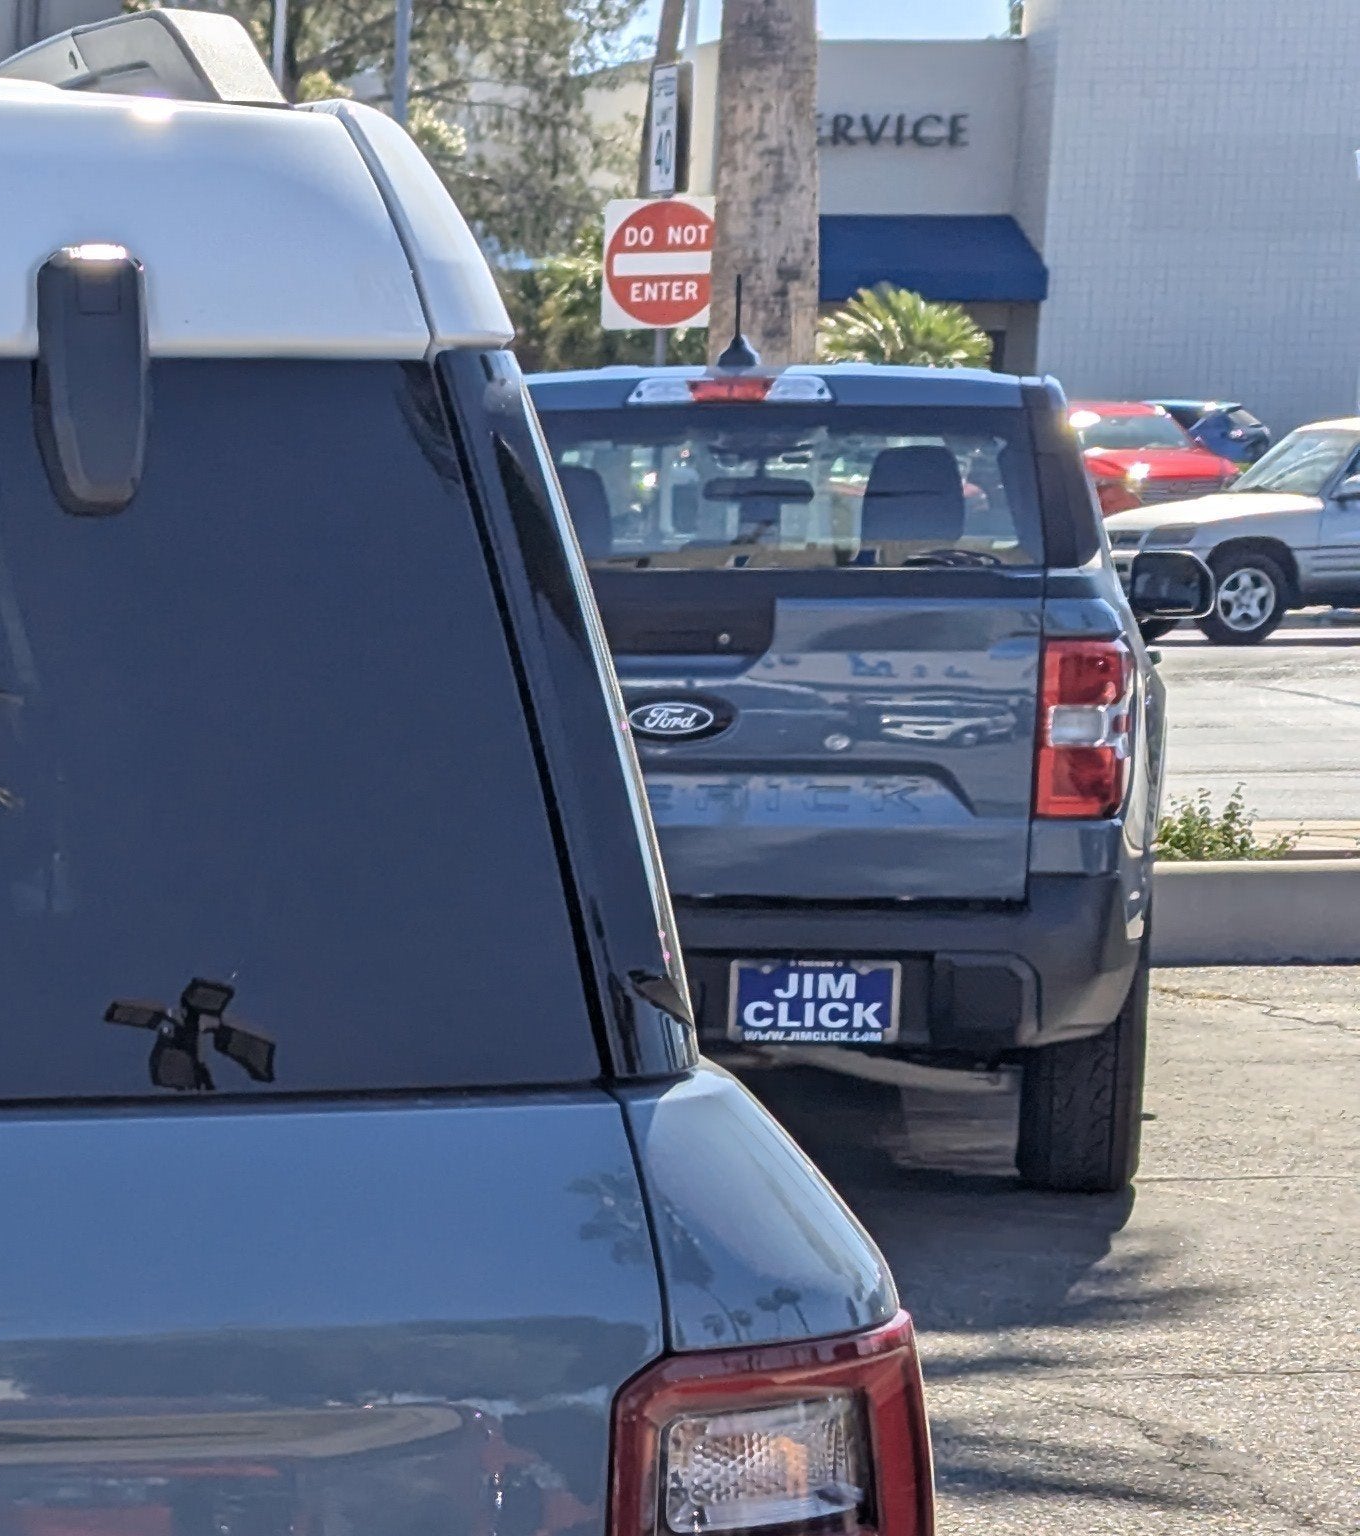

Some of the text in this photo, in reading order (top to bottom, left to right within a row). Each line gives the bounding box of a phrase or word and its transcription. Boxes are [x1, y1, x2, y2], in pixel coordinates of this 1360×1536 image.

[624, 224, 710, 247] DO NOT
[630, 281, 699, 302] ENTER
[644, 707, 698, 729] Ford
[774, 973, 857, 999] JIM
[743, 1001, 883, 1028] CLICK
